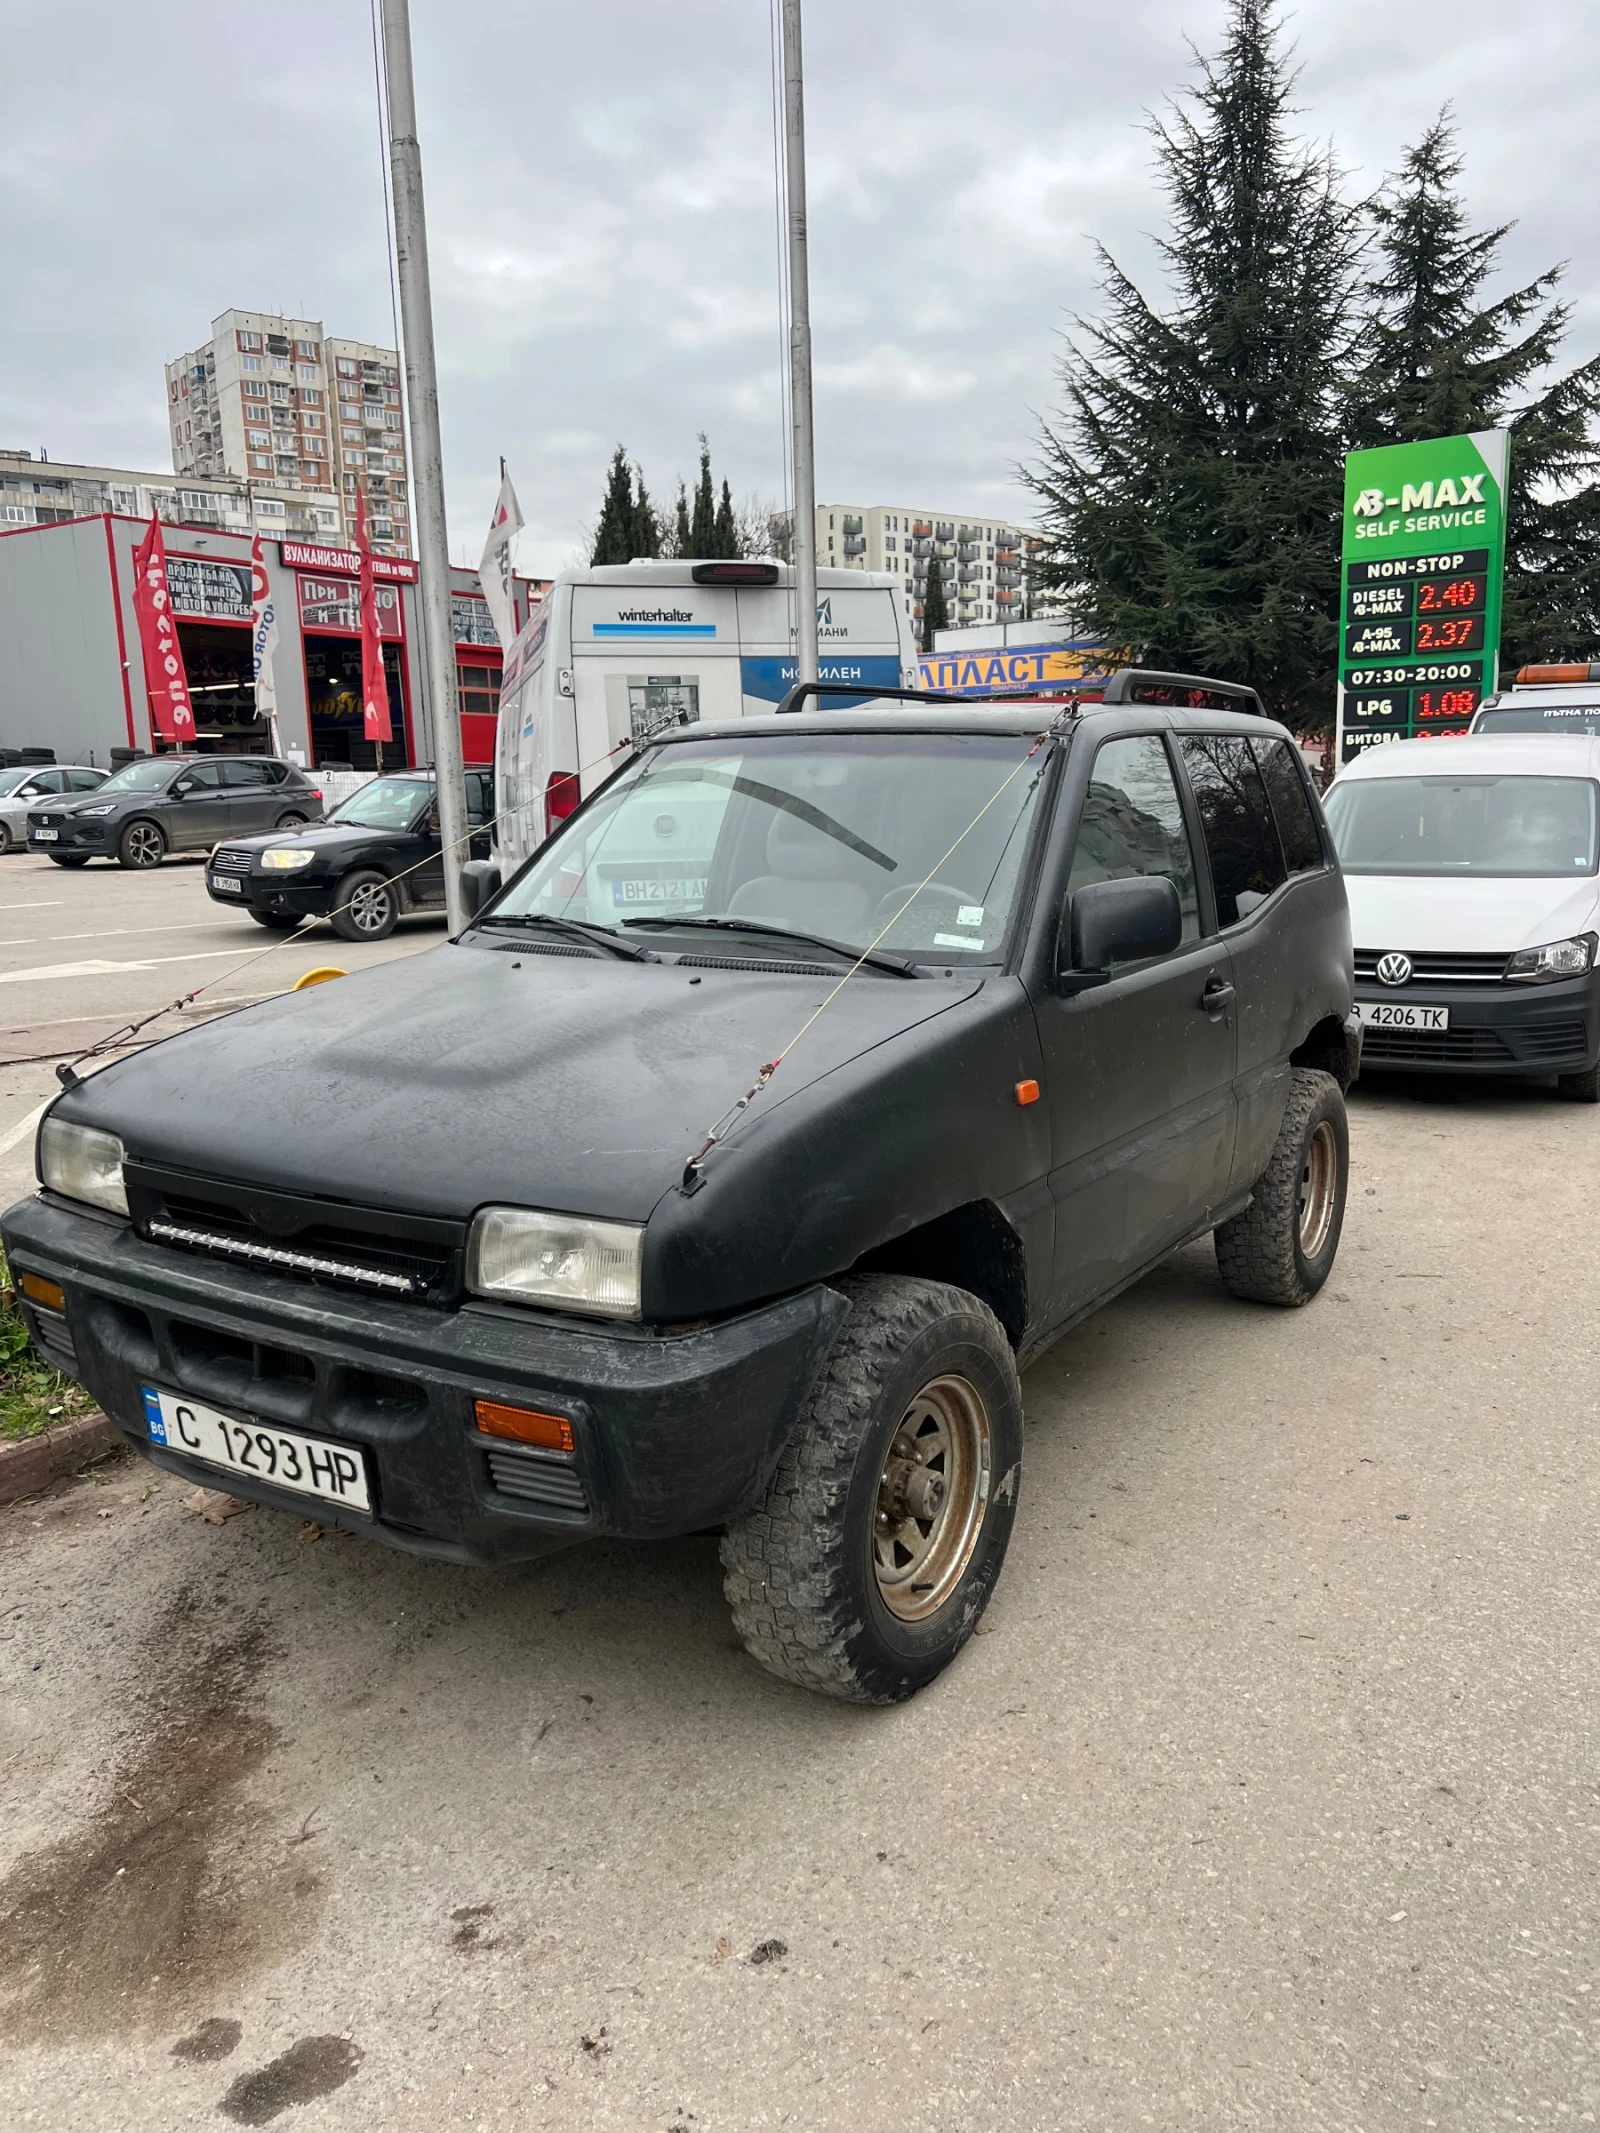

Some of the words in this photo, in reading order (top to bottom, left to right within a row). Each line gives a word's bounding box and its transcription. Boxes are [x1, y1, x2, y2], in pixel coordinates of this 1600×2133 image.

[1354, 520, 1400, 539] SELF
[1404, 509, 1487, 533] SERVICE
[283, 544, 361, 571] ВУЛКАНИЗАТОР
[1367, 555, 1465, 579] NON-STOP
[219, 570, 231, 582] НА
[200, 585, 236, 599] ЖАНТИ
[1352, 588, 1405, 604] DIESEL
[1419, 581, 1477, 609] 2.40
[618, 608, 693, 622] winterhalter
[1361, 627, 1393, 640] A-95
[1418, 620, 1473, 648] 2.37
[1351, 664, 1472, 685] 07:30-20:00
[1356, 699, 1393, 716] LPG
[1419, 690, 1475, 717] 1.08
[1543, 708, 1582, 718] ПЪТНА
[326, 771, 332, 782] 2
[624, 882, 647, 900] BH
[649, 880, 688, 899] 2121
[1371, 1006, 1416, 1026] 4206
[1420, 1009, 1445, 1028] TK
[150, 1420, 165, 1437] BG
[176, 1406, 201, 1448] C
[217, 1420, 303, 1481] 1293
[306, 1445, 358, 1496] HP
